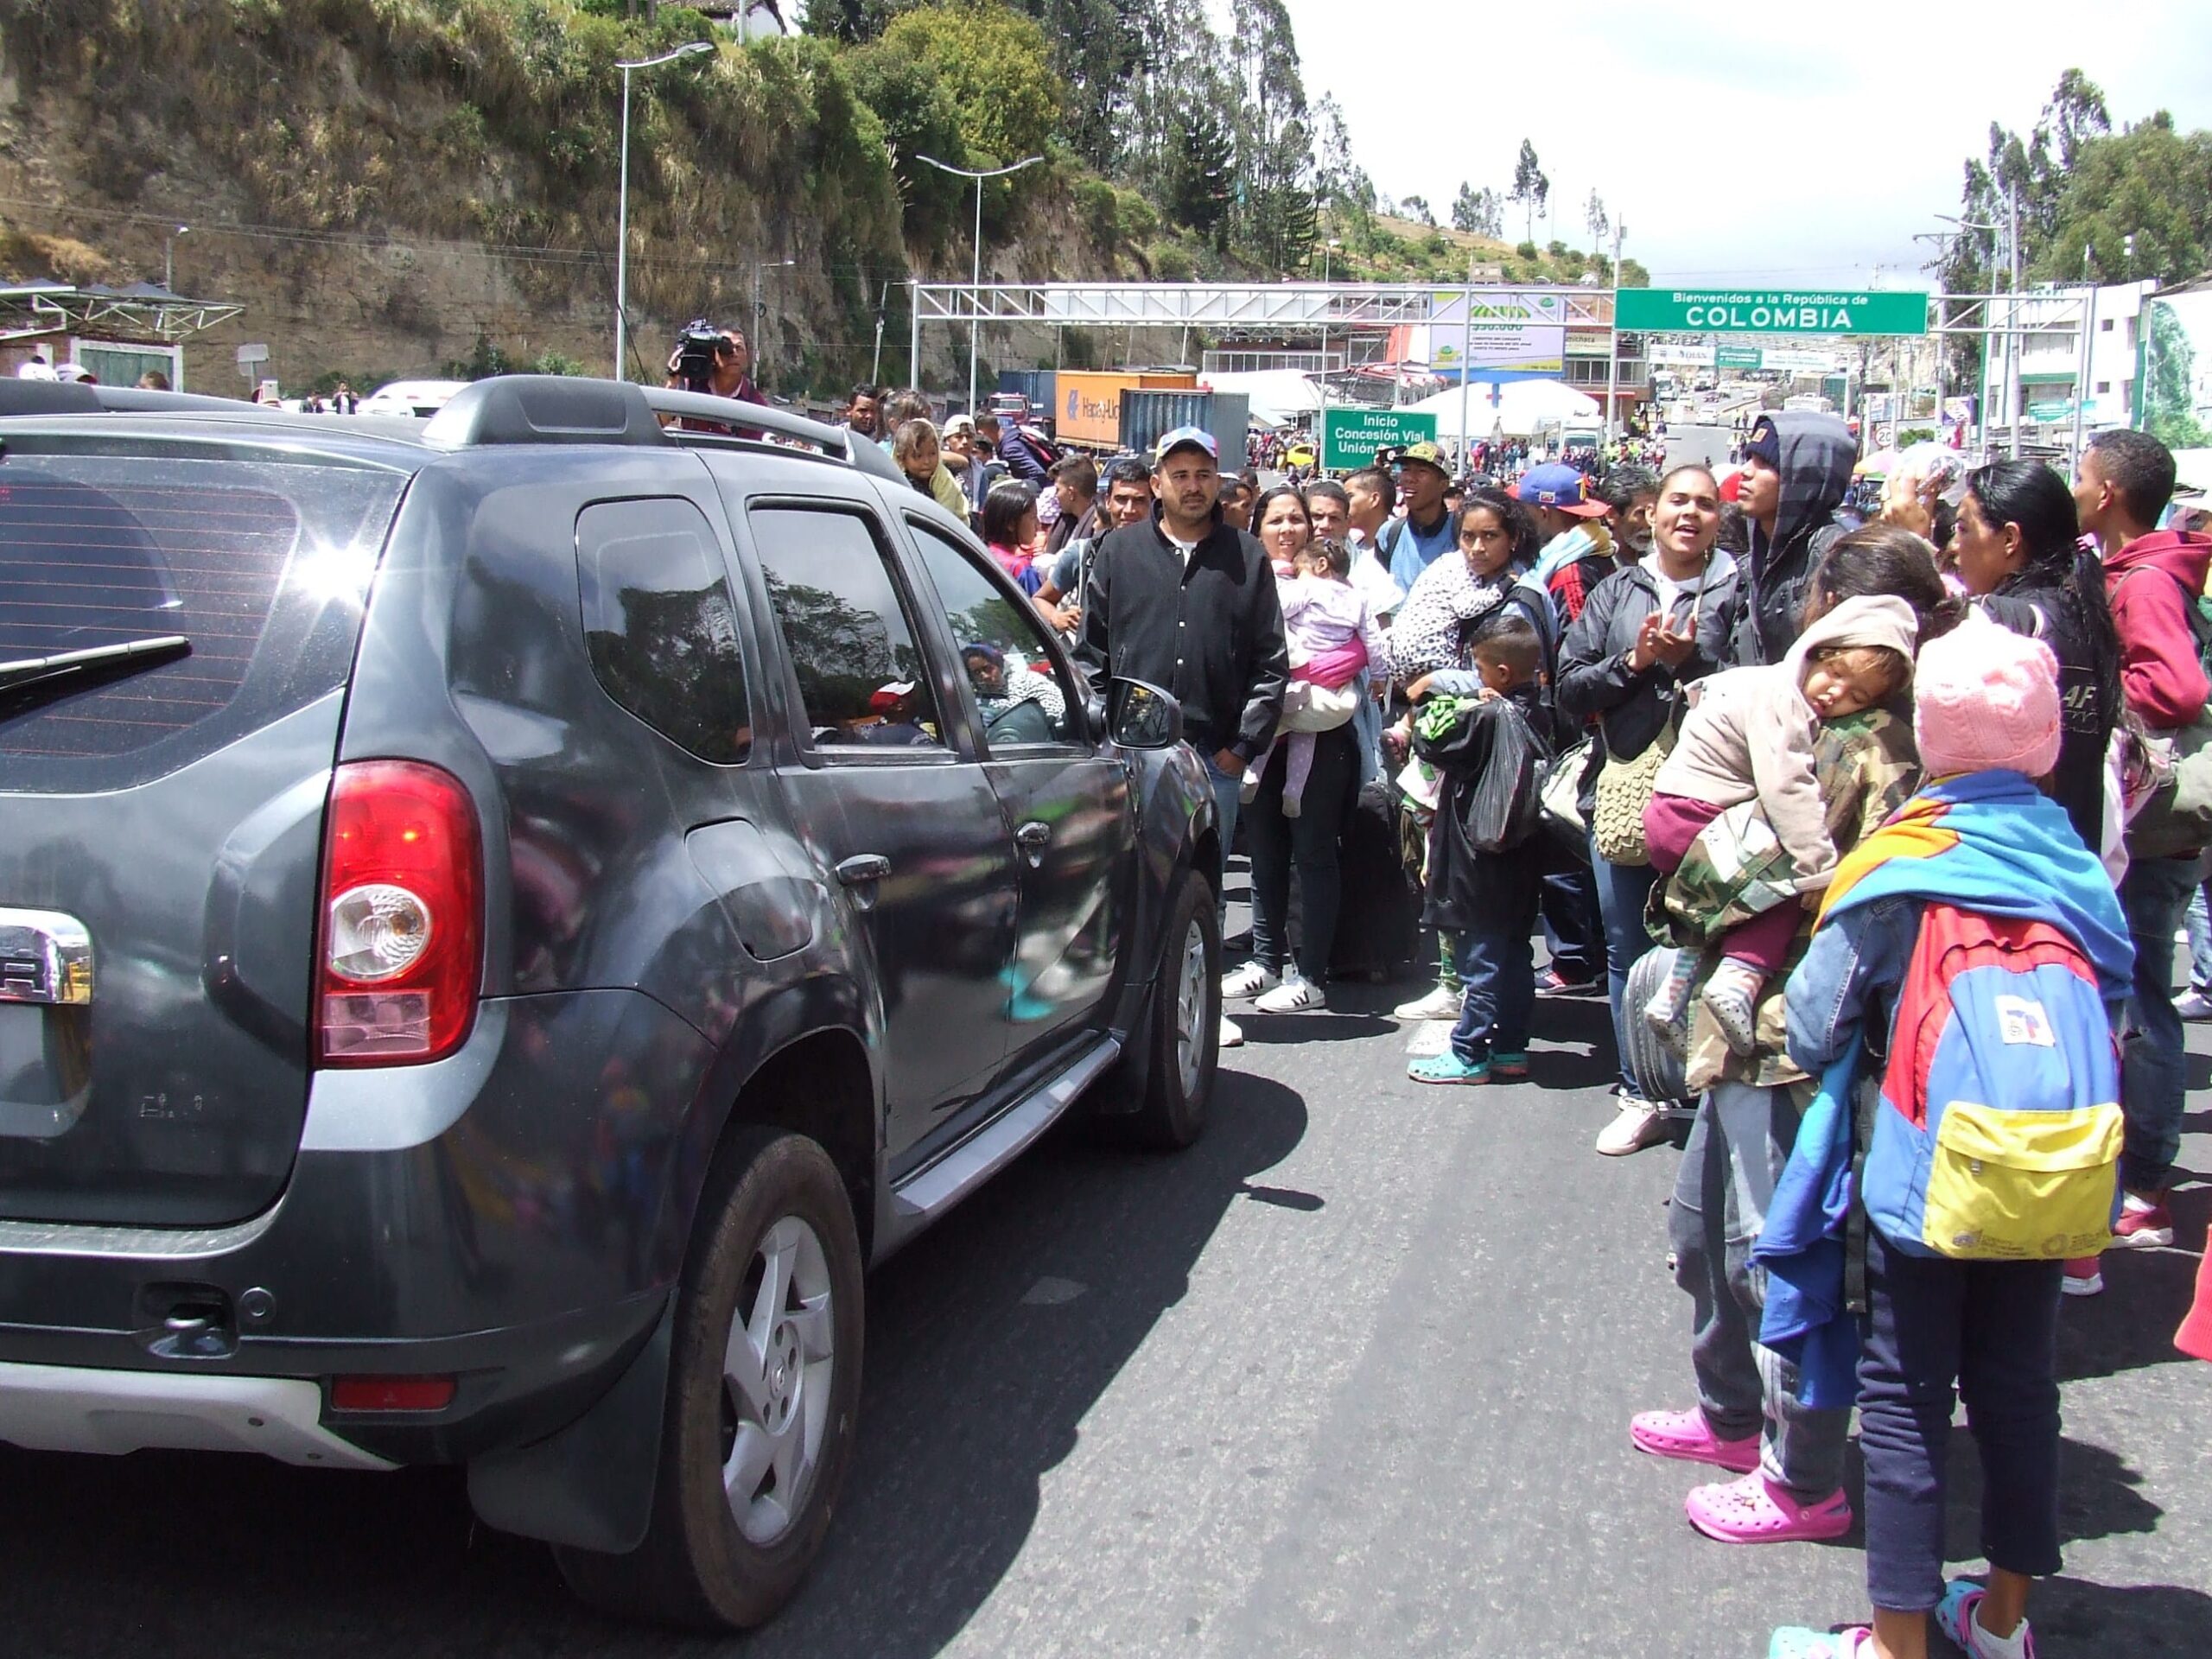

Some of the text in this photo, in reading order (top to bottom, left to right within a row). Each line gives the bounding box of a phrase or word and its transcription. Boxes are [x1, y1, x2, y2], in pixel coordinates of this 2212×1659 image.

[1673, 292, 1868, 306] Bienvenidos a la República de
[1686, 306, 1853, 328] COLOMBIA
[1363, 414, 1398, 427] Inicio
[1335, 427, 1425, 442] Concesión Vial
[1338, 441, 1374, 454] Unión
